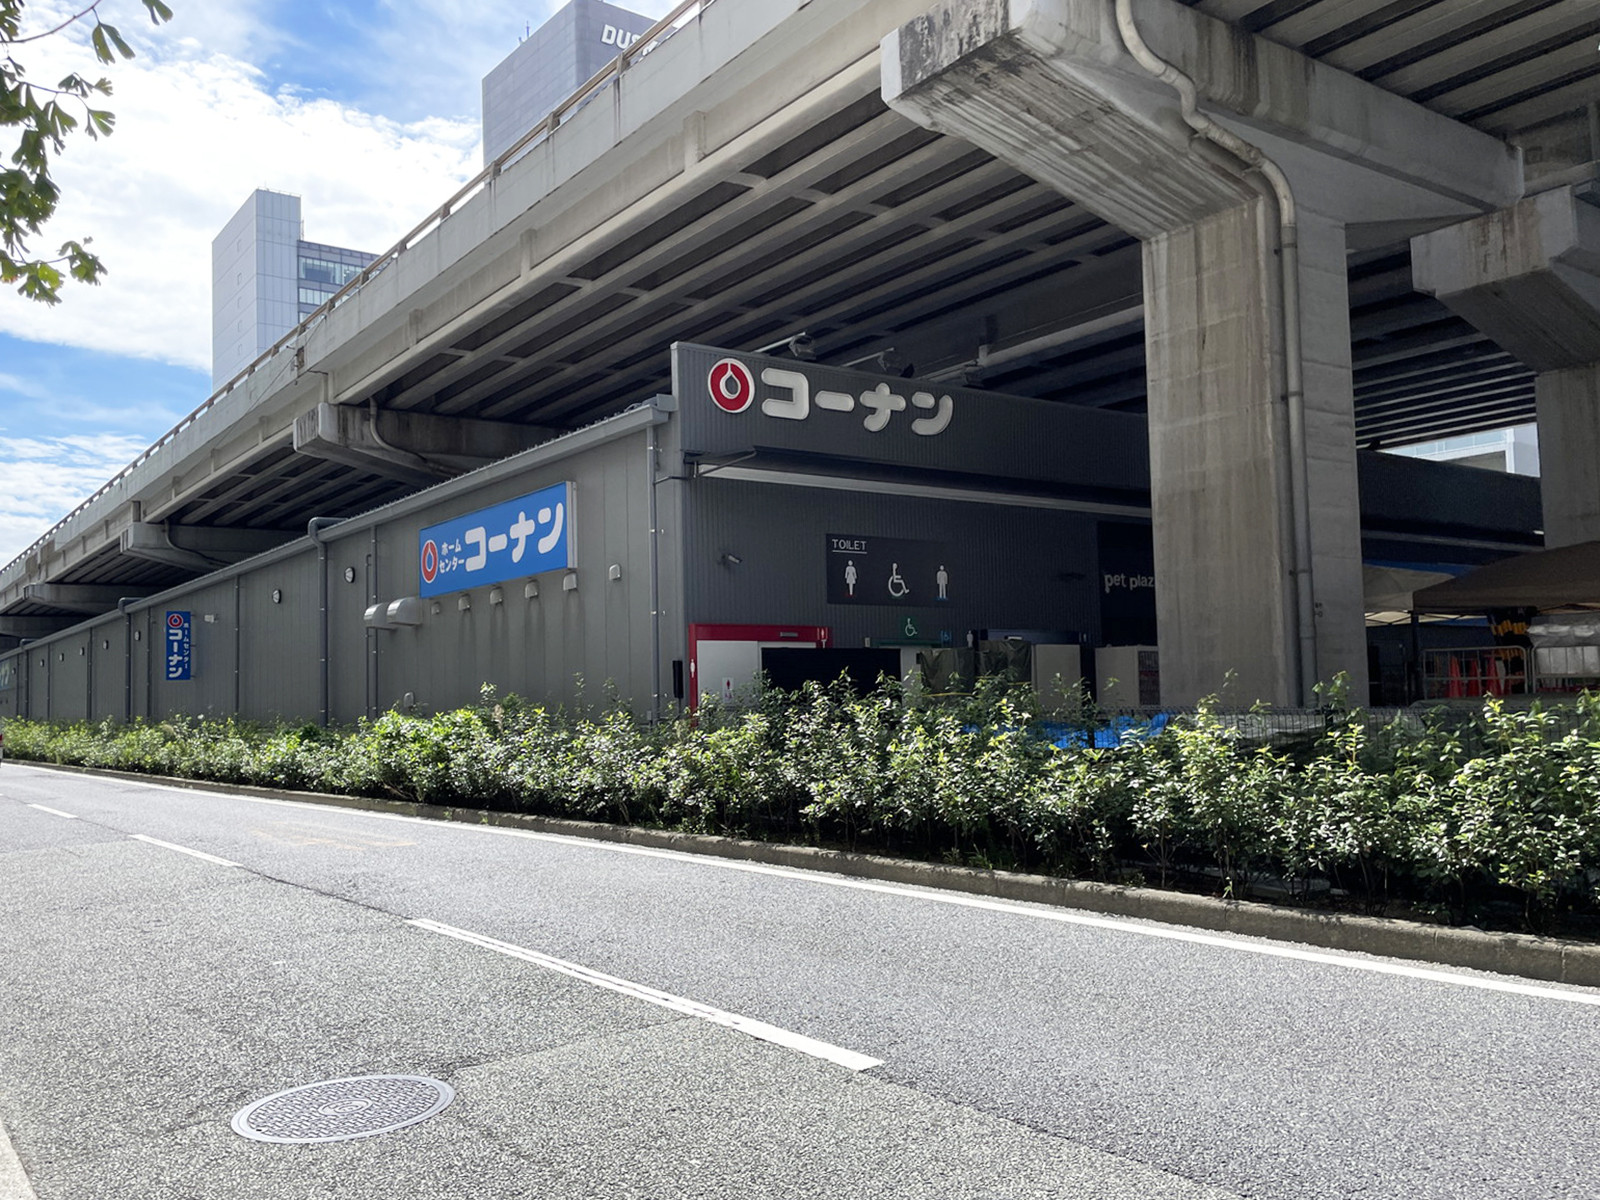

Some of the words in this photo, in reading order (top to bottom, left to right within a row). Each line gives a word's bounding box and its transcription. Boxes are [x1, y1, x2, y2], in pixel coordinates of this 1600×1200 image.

[761, 367, 953, 435] コーナン
[441, 538, 462, 556] ホーム
[465, 502, 564, 572] コーナン
[831, 538, 867, 551] TOILET
[439, 555, 465, 574] センター
[1104, 573, 1127, 594] pet
[168, 629, 183, 678] コーナン
